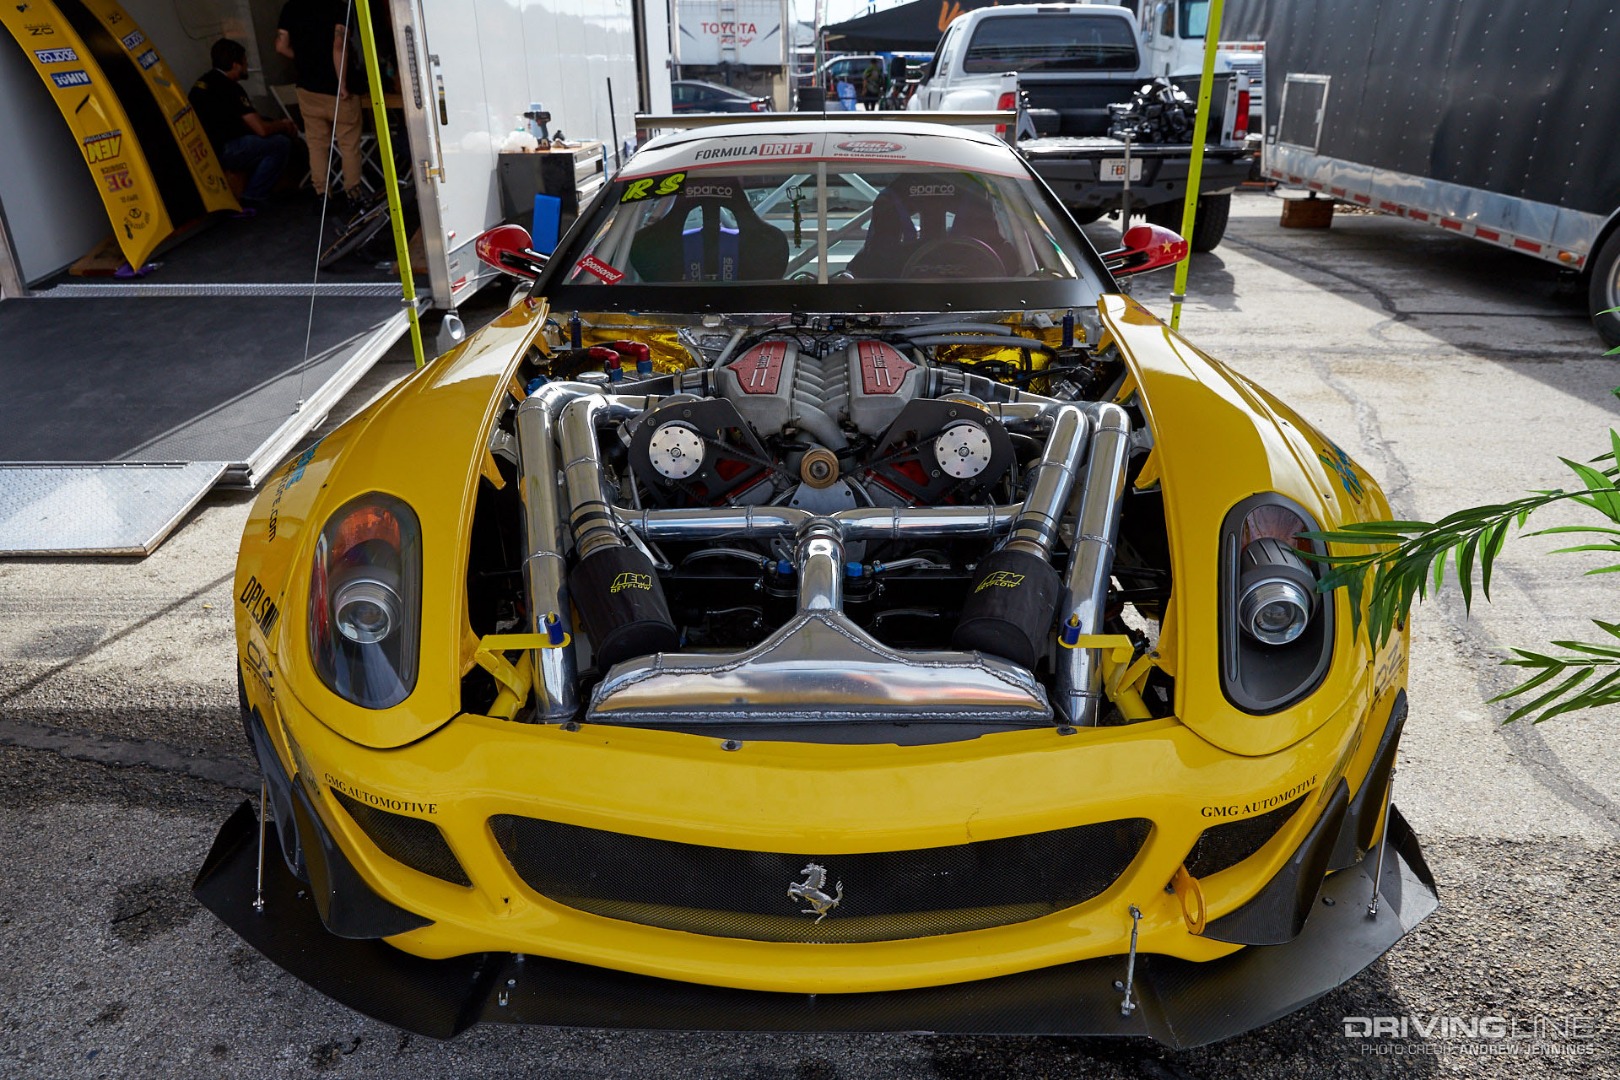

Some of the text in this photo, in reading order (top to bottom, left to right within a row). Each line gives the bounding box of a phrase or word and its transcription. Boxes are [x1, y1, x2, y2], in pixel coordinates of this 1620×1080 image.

[701, 22, 757, 34] TOYOTA
[695, 142, 810, 161] FORMULA DRIFT
[686, 184, 733, 198] sparco
[908, 184, 955, 197] sparco
[582, 257, 622, 281] Sponsored
[613, 572, 652, 586] AEM
[324, 772, 347, 792] GMG
[348, 786, 438, 815] AUTOMOTIVE
[1201, 774, 1318, 818] GMG AUTOMOTIVE
